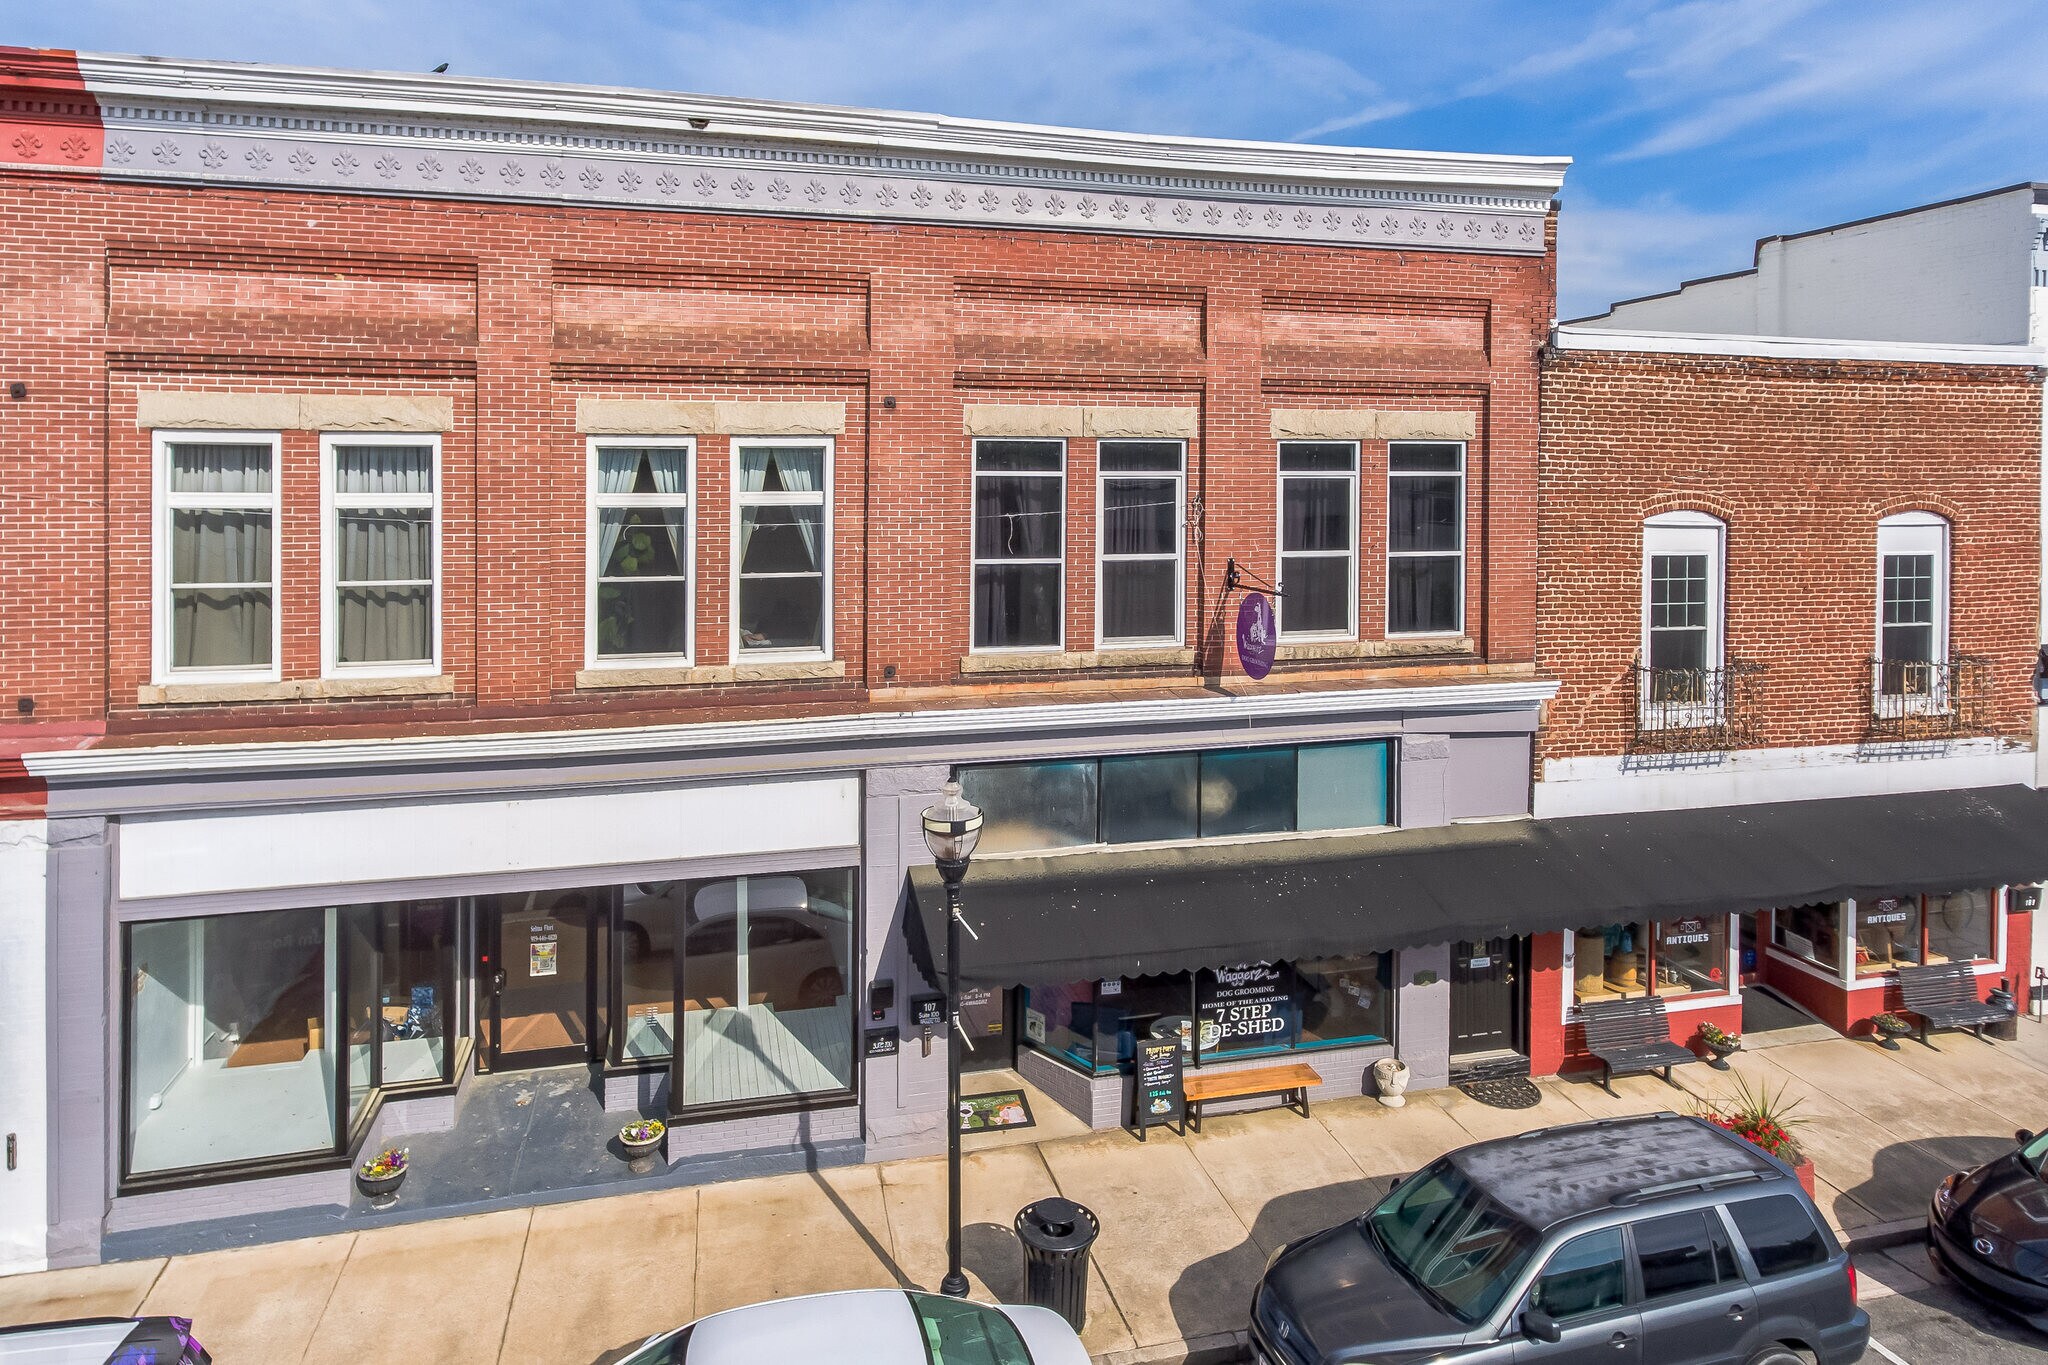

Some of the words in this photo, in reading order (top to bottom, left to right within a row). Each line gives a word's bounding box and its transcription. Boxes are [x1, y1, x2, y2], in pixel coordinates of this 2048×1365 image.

[1867, 912, 1907, 924] ANTIQUES
[1666, 933, 1709, 945] ANTIQUES
[1216, 989, 1233, 998] DOG
[1234, 985, 1275, 996] GROOMING
[923, 1002, 937, 1012] 107
[1202, 1001, 1225, 1010] HOME
[1254, 995, 1289, 1004] AMAZING
[1216, 1008, 1226, 1023] 7
[1230, 1004, 1272, 1021] STEP
[1210, 1017, 1285, 1039] DE-SHED
